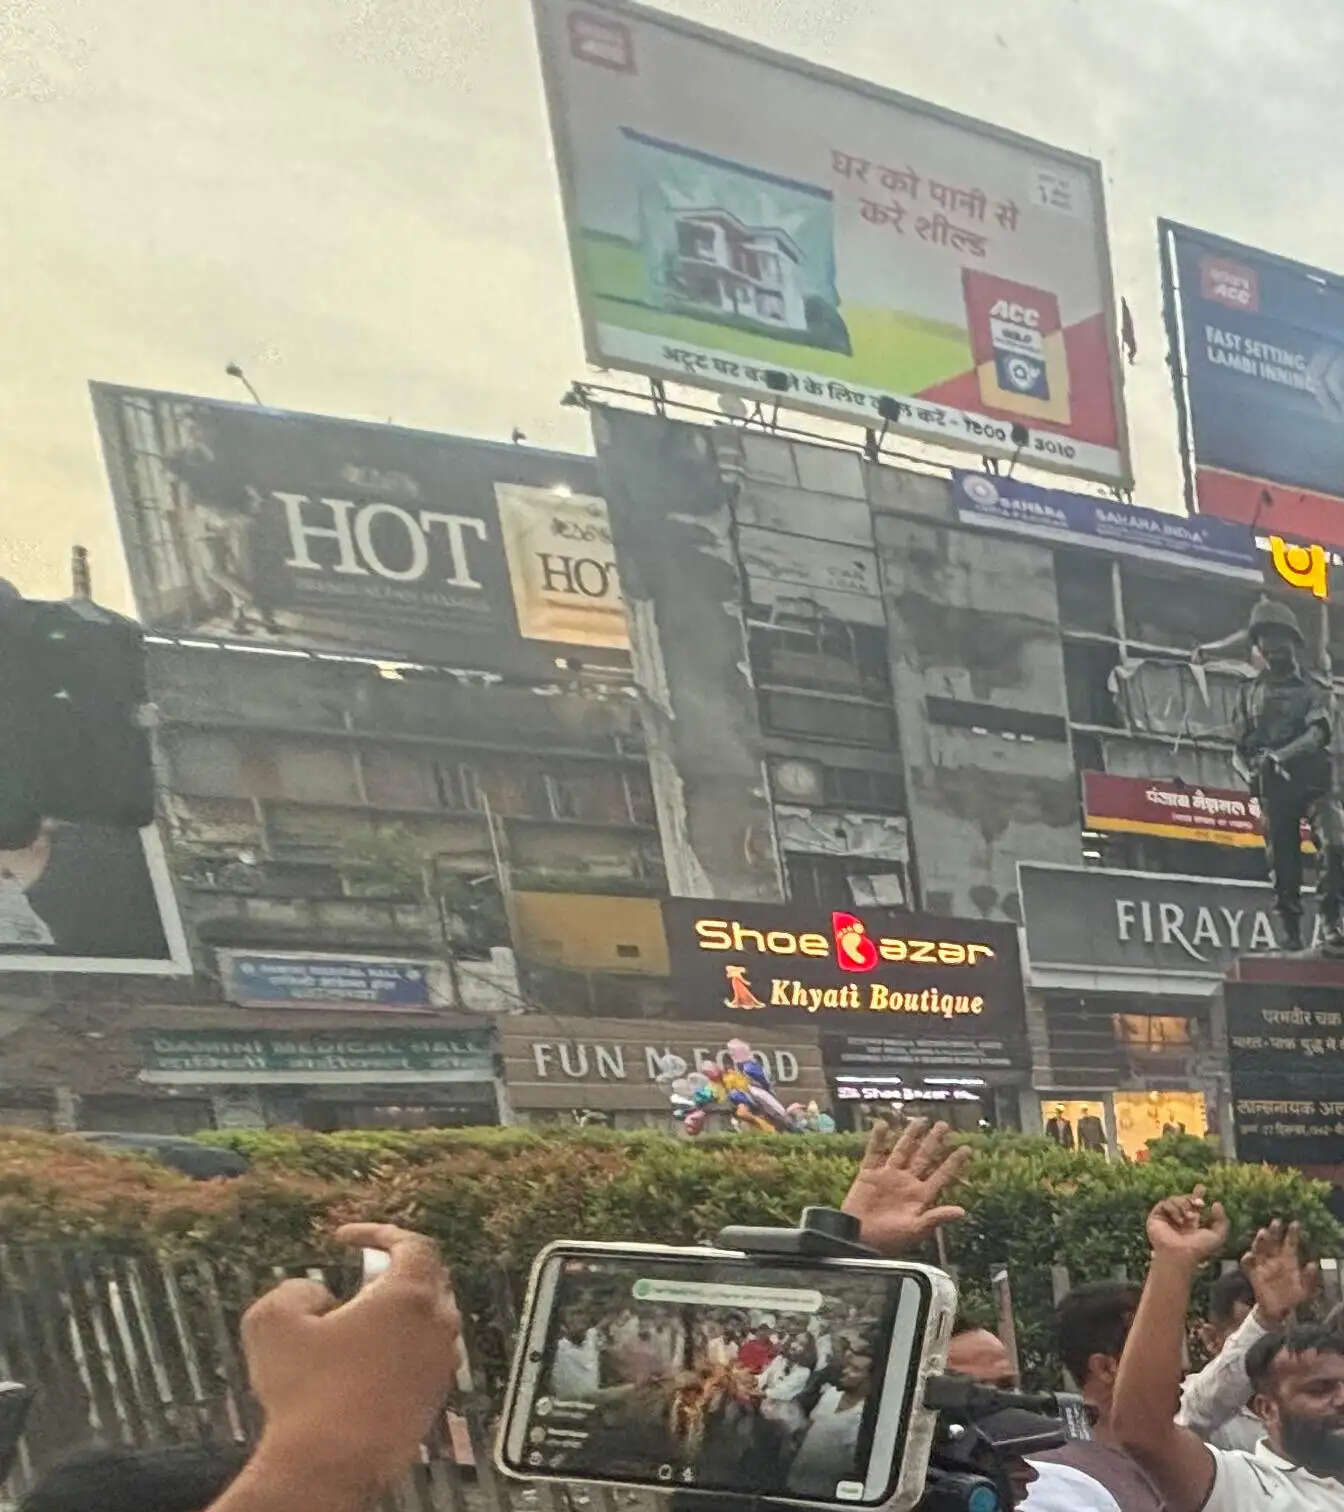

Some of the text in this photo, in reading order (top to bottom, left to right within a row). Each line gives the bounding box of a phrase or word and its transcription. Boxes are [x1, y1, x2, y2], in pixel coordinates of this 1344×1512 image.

[830, 149, 1020, 231] घर को पानी से
[914, 213, 989, 257] शील्ड
[989, 299, 1040, 326] ACC
[1205, 325, 1305, 370] FAST SETTING
[965, 419, 1006, 441] 1800
[1034, 438, 1076, 459] 3010
[272, 489, 487, 589] HOT
[696, 917, 829, 955] Shoe
[771, 978, 985, 1019] Khyati Boutique
[531, 1042, 627, 1081] FUN
